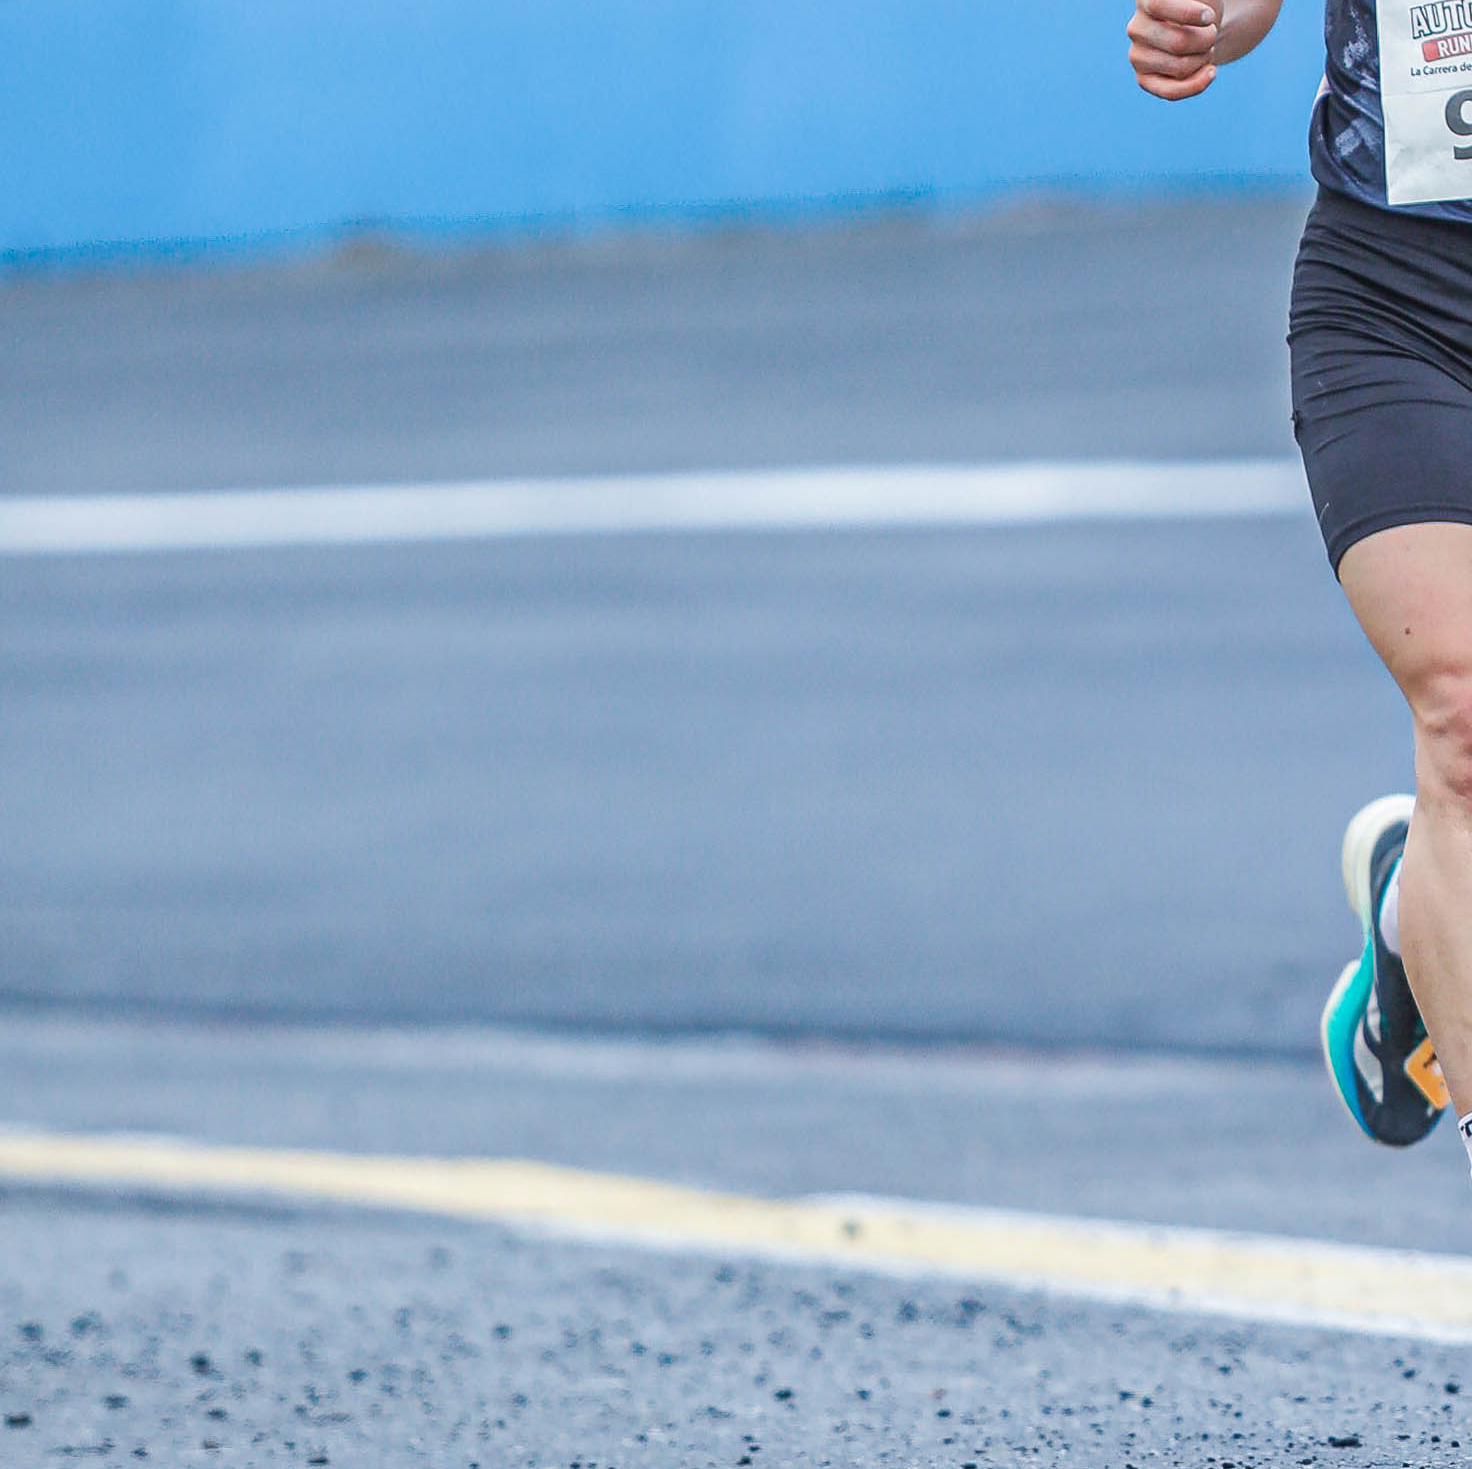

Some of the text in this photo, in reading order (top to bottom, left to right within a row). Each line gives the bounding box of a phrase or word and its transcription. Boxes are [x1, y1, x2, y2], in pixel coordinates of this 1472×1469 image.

[1410, 67, 1421, 76] La
[1423, 65, 1458, 75] Carrera
[1460, 61, 1472, 72] de
